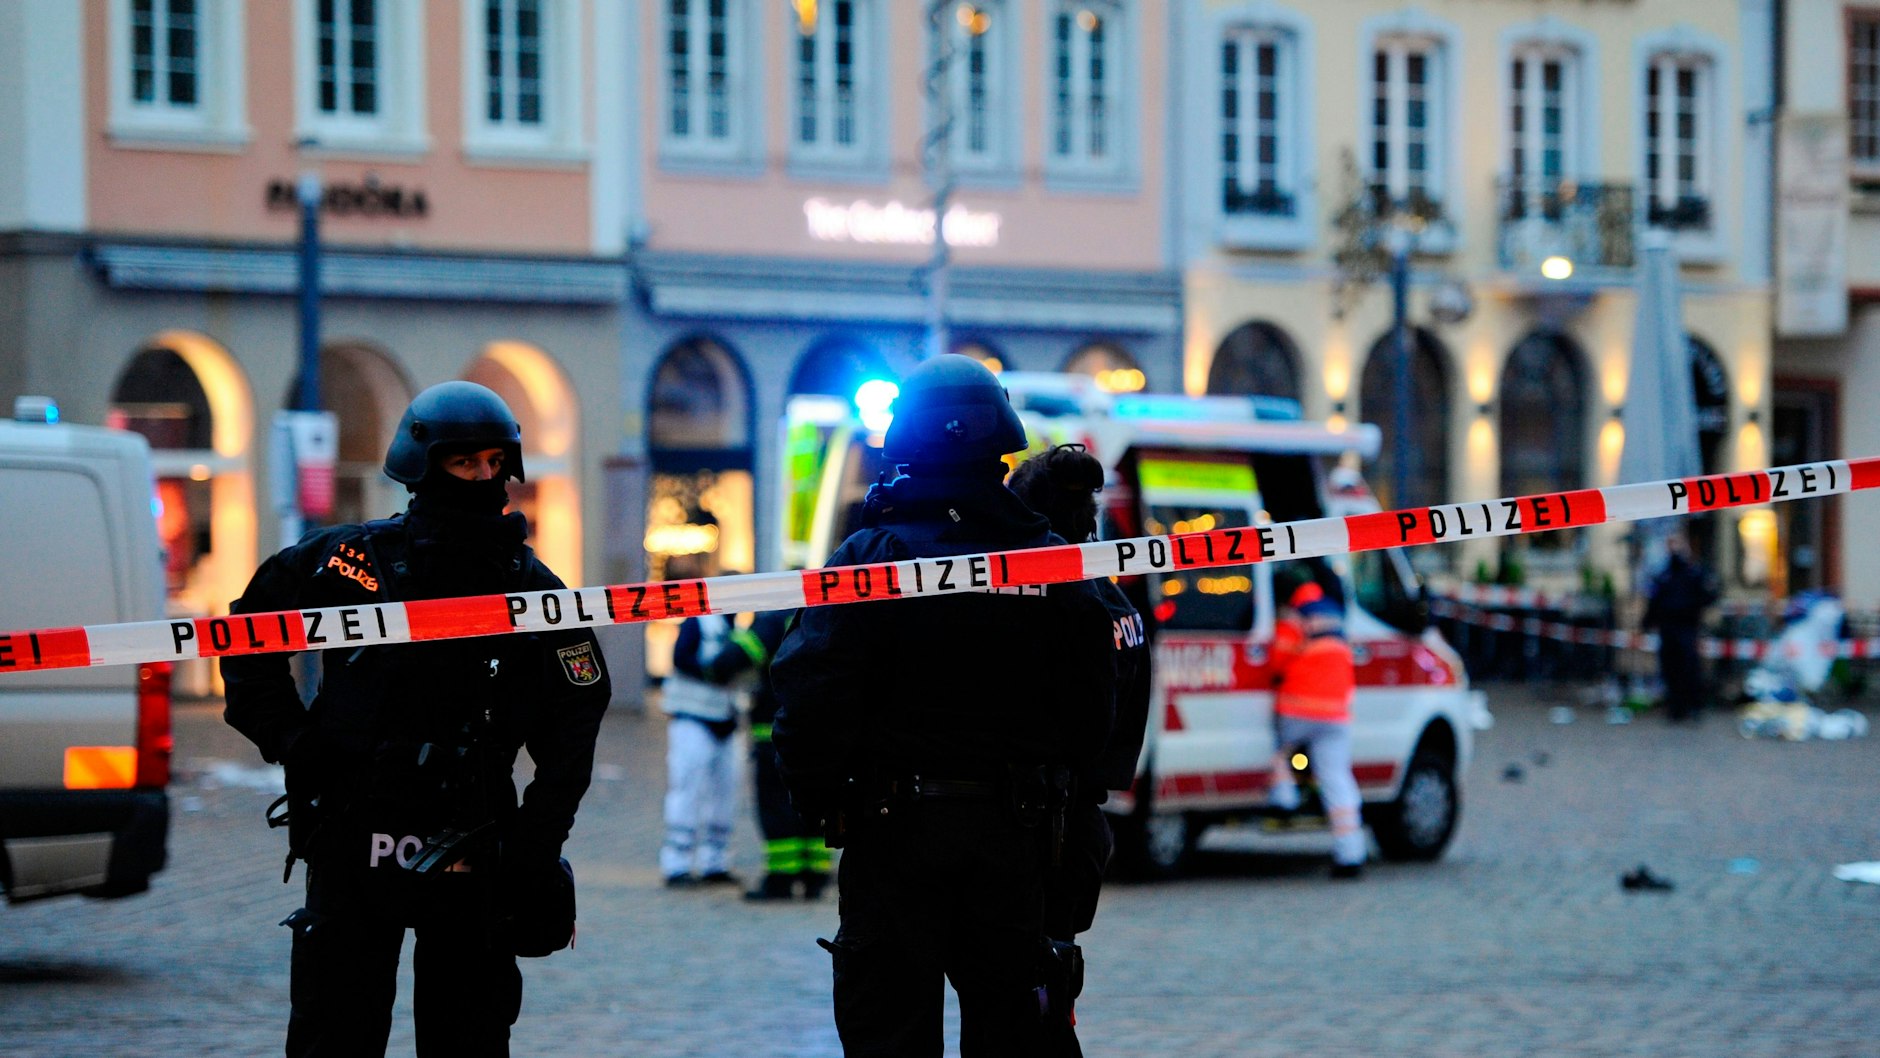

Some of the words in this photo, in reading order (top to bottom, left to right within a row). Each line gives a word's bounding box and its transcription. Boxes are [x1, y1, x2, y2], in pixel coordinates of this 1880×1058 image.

[1667, 464, 1837, 511] POLIZEI
[1396, 494, 1572, 543] POLIZEI
[1115, 525, 1297, 573] POLIZEI
[327, 555, 379, 592] POLIZEI
[818, 553, 1009, 602] POLIZEI
[507, 581, 709, 628] POLIZEI
[170, 606, 387, 655] POLIZEI
[560, 645, 590, 659] POLIZEI
